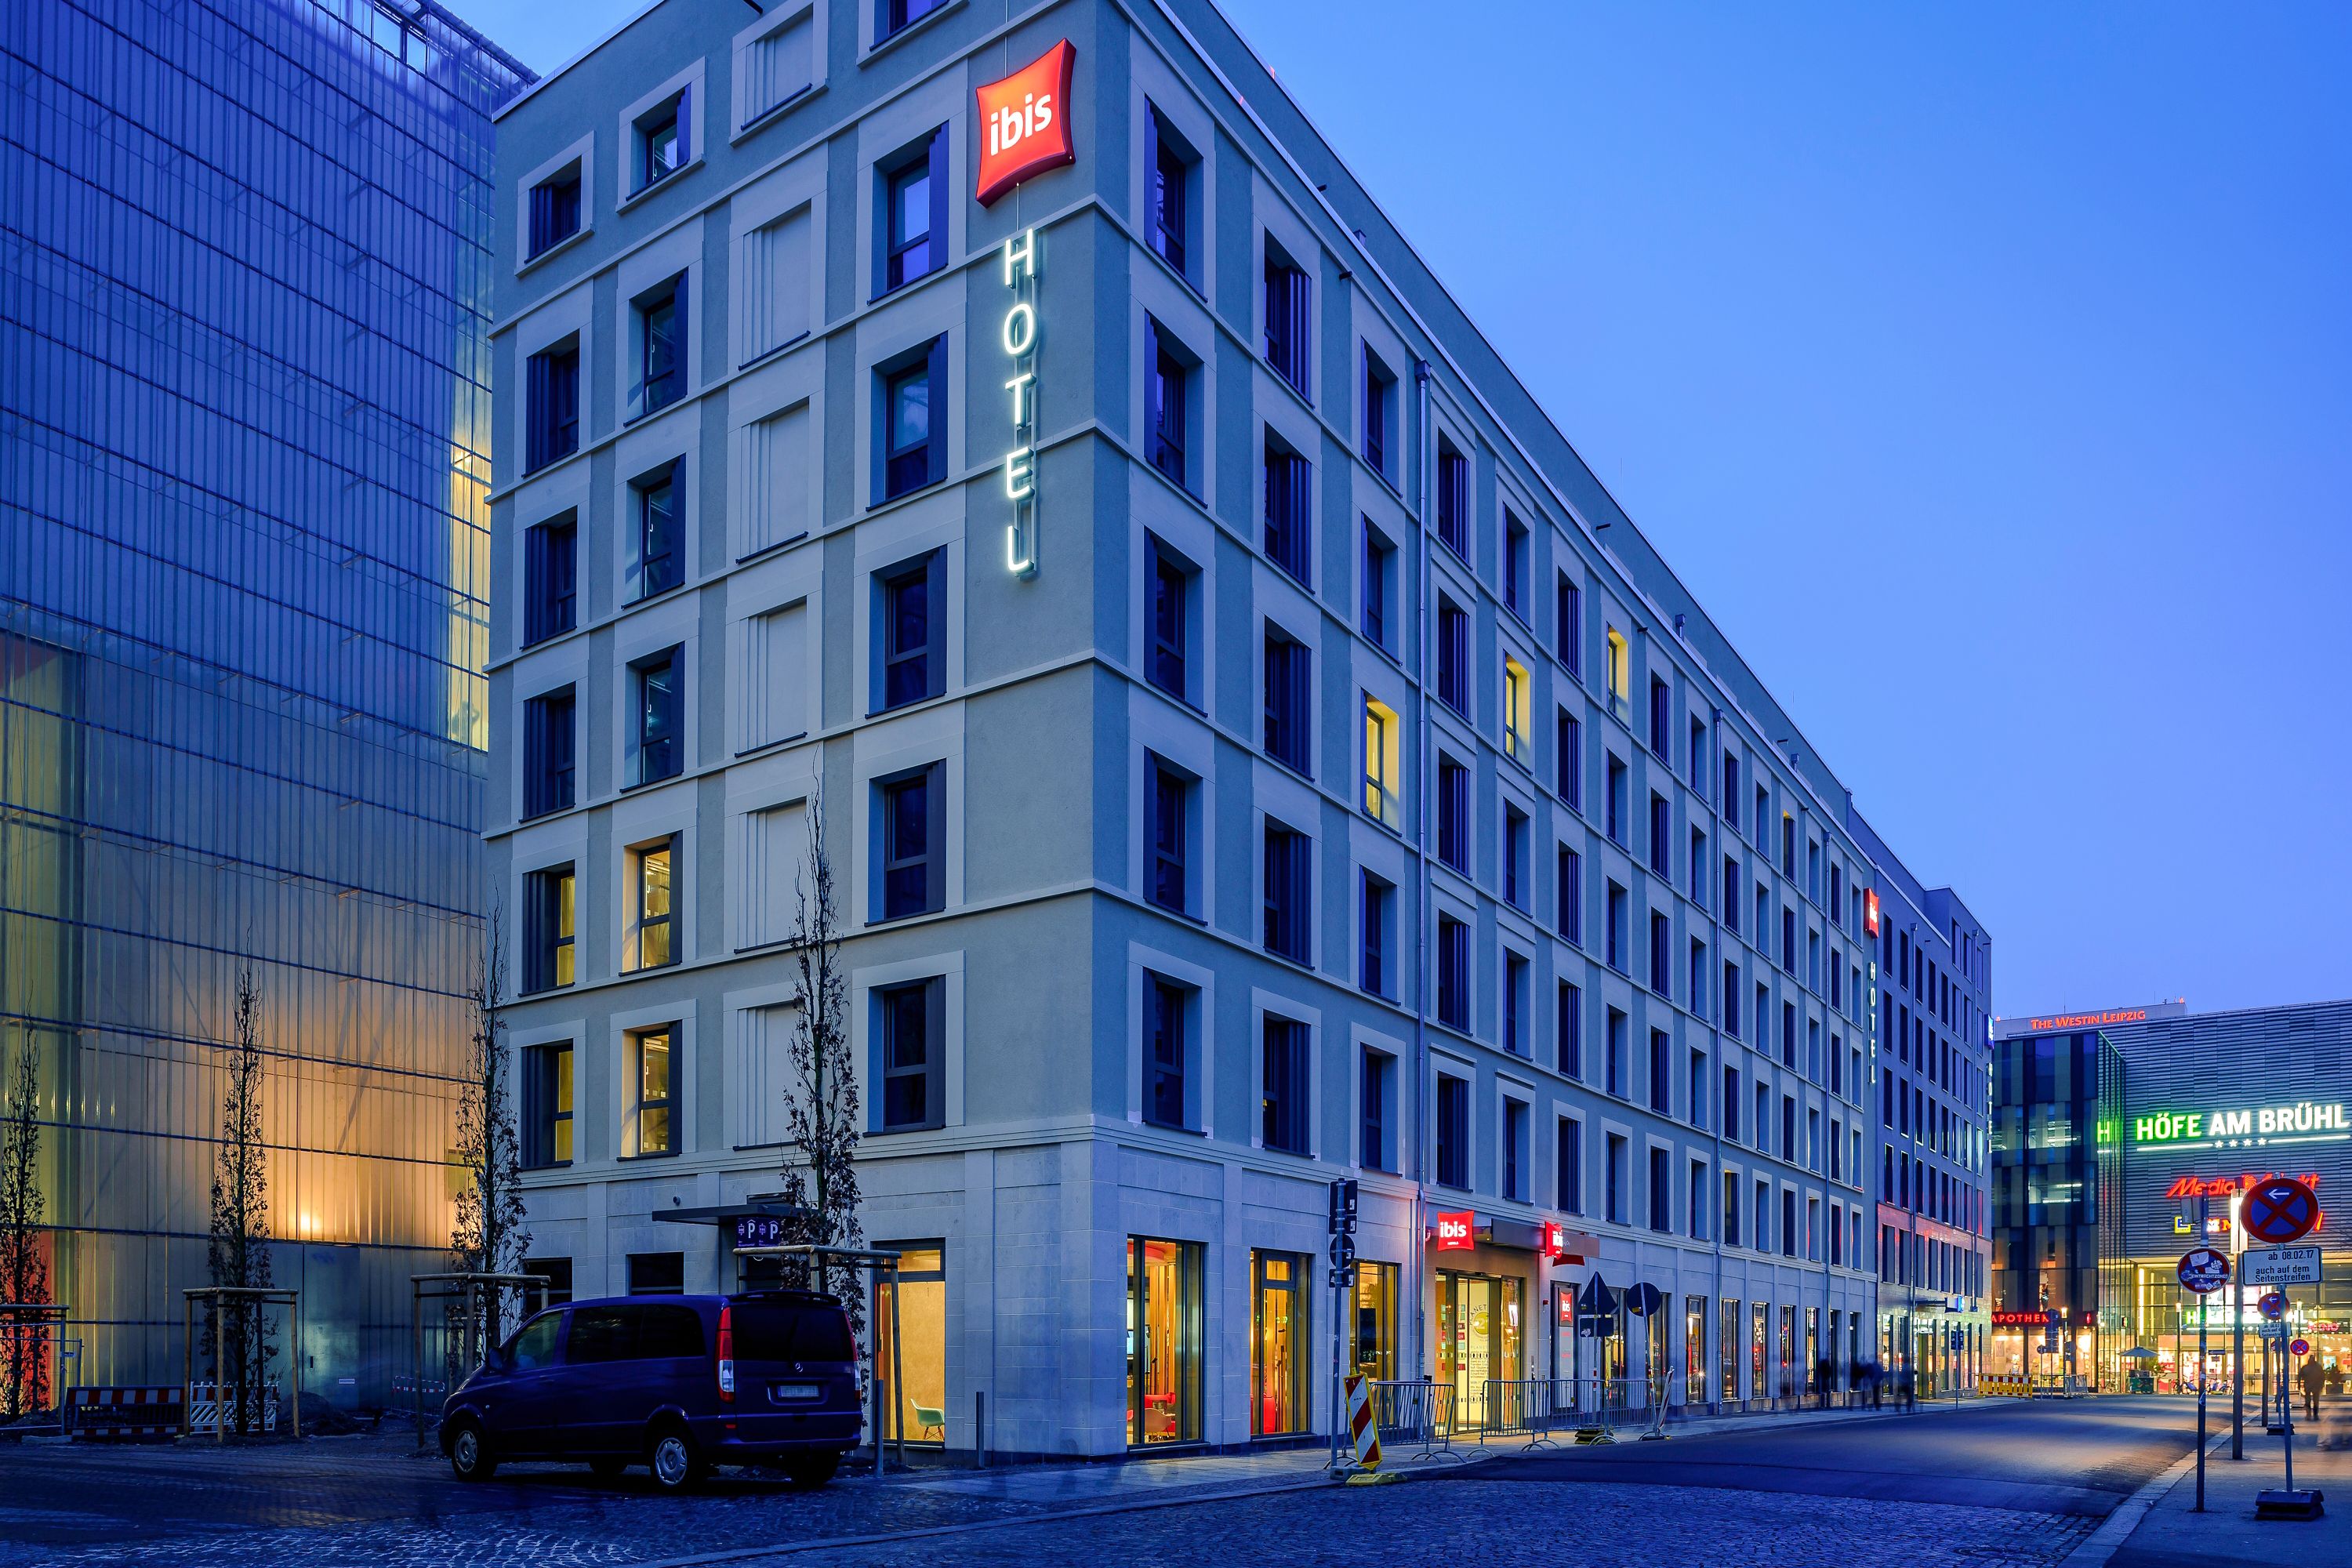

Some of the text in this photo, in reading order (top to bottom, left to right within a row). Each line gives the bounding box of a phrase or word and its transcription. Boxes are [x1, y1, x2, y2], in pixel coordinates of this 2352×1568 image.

[990, 93, 1052, 156] ibis
[1004, 227, 1035, 573] HOTEL
[2031, 1010, 2146, 1029] THE WESTIN LEIPZIG
[2136, 1102, 2350, 1141] HÖFE AM BRÜHL
[2166, 1177, 2236, 1197] Media
[1439, 1221, 1467, 1238] ibis
[2282, 1250, 2314, 1260] 08.02.17
[2256, 1266, 2274, 1275] auch
[2256, 1273, 2310, 1283] Seitenstreifen
[1991, 1313, 2049, 1323] APOTHEK
